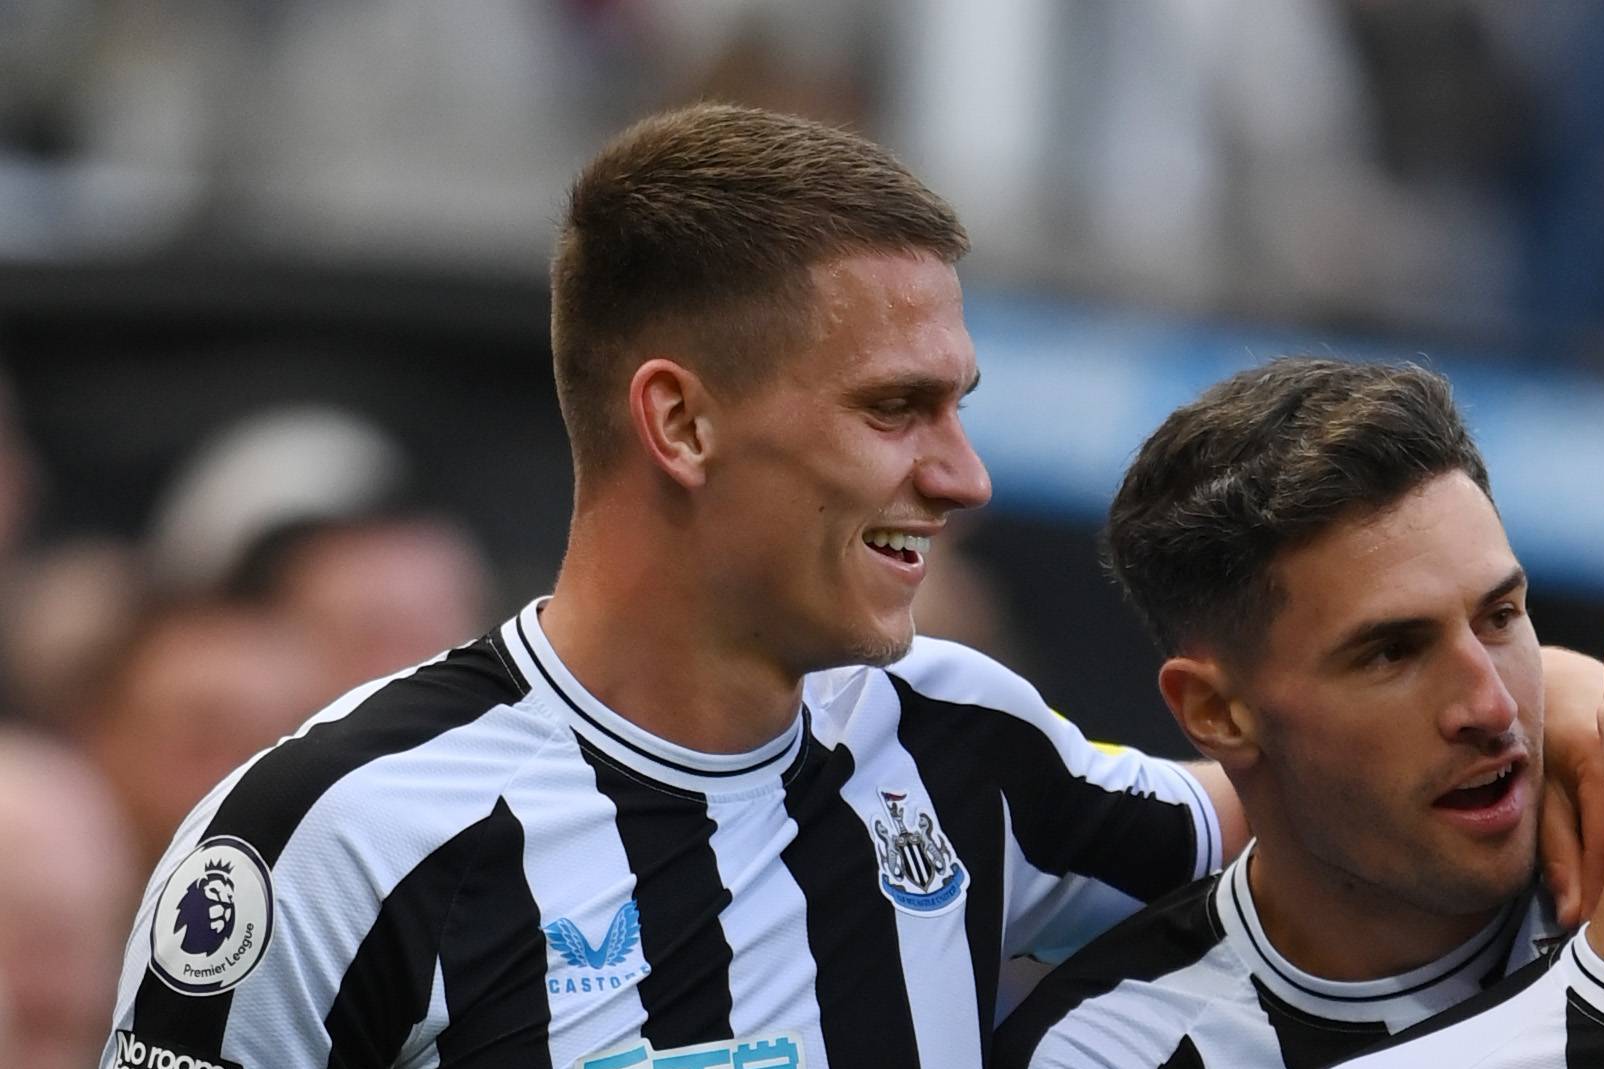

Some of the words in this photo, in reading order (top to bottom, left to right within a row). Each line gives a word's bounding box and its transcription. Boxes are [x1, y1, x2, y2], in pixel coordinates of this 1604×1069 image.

[183, 963, 226, 978] Premier
[225, 922, 255, 967] League
[117, 1031, 147, 1066] No
